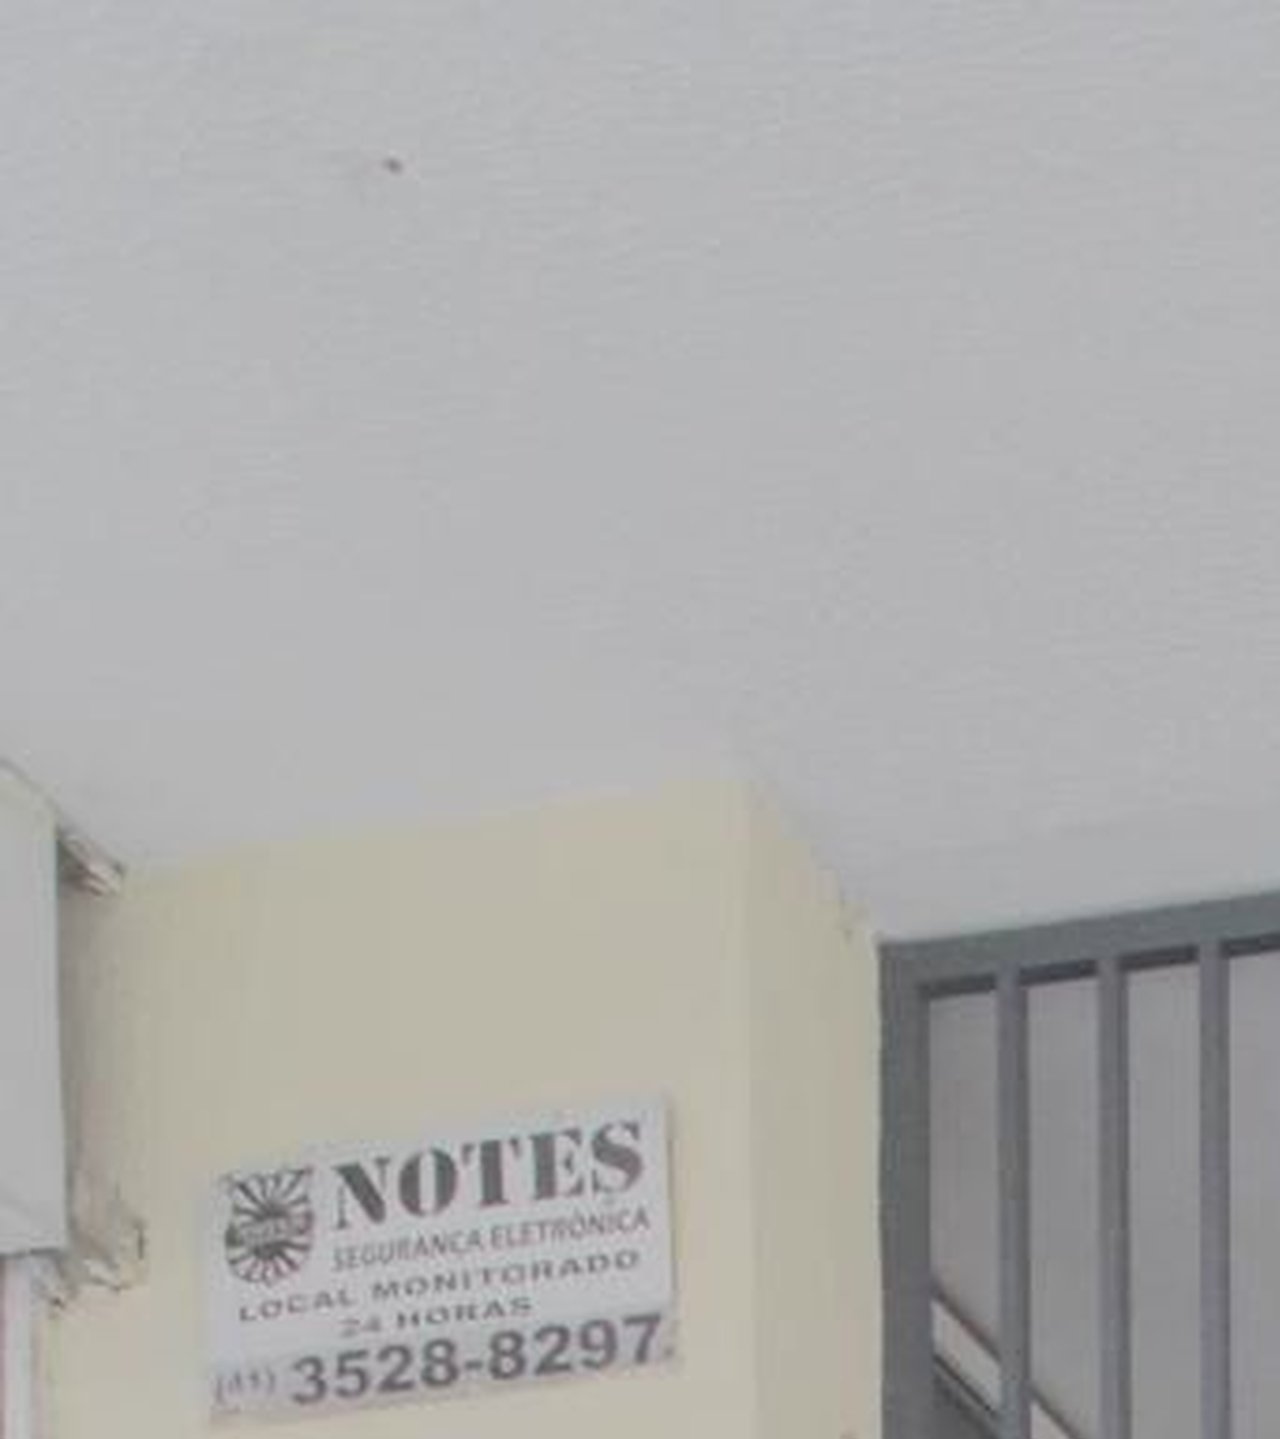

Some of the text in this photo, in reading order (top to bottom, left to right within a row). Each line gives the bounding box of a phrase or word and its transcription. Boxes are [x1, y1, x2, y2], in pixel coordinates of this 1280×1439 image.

[332, 1119, 646, 1231] NOTES
[239, 1249, 641, 1322] LOCAL MONITORADO
[338, 1296, 534, 1339] 24 HORAS
[292, 1312, 664, 1406] 3528-8297
